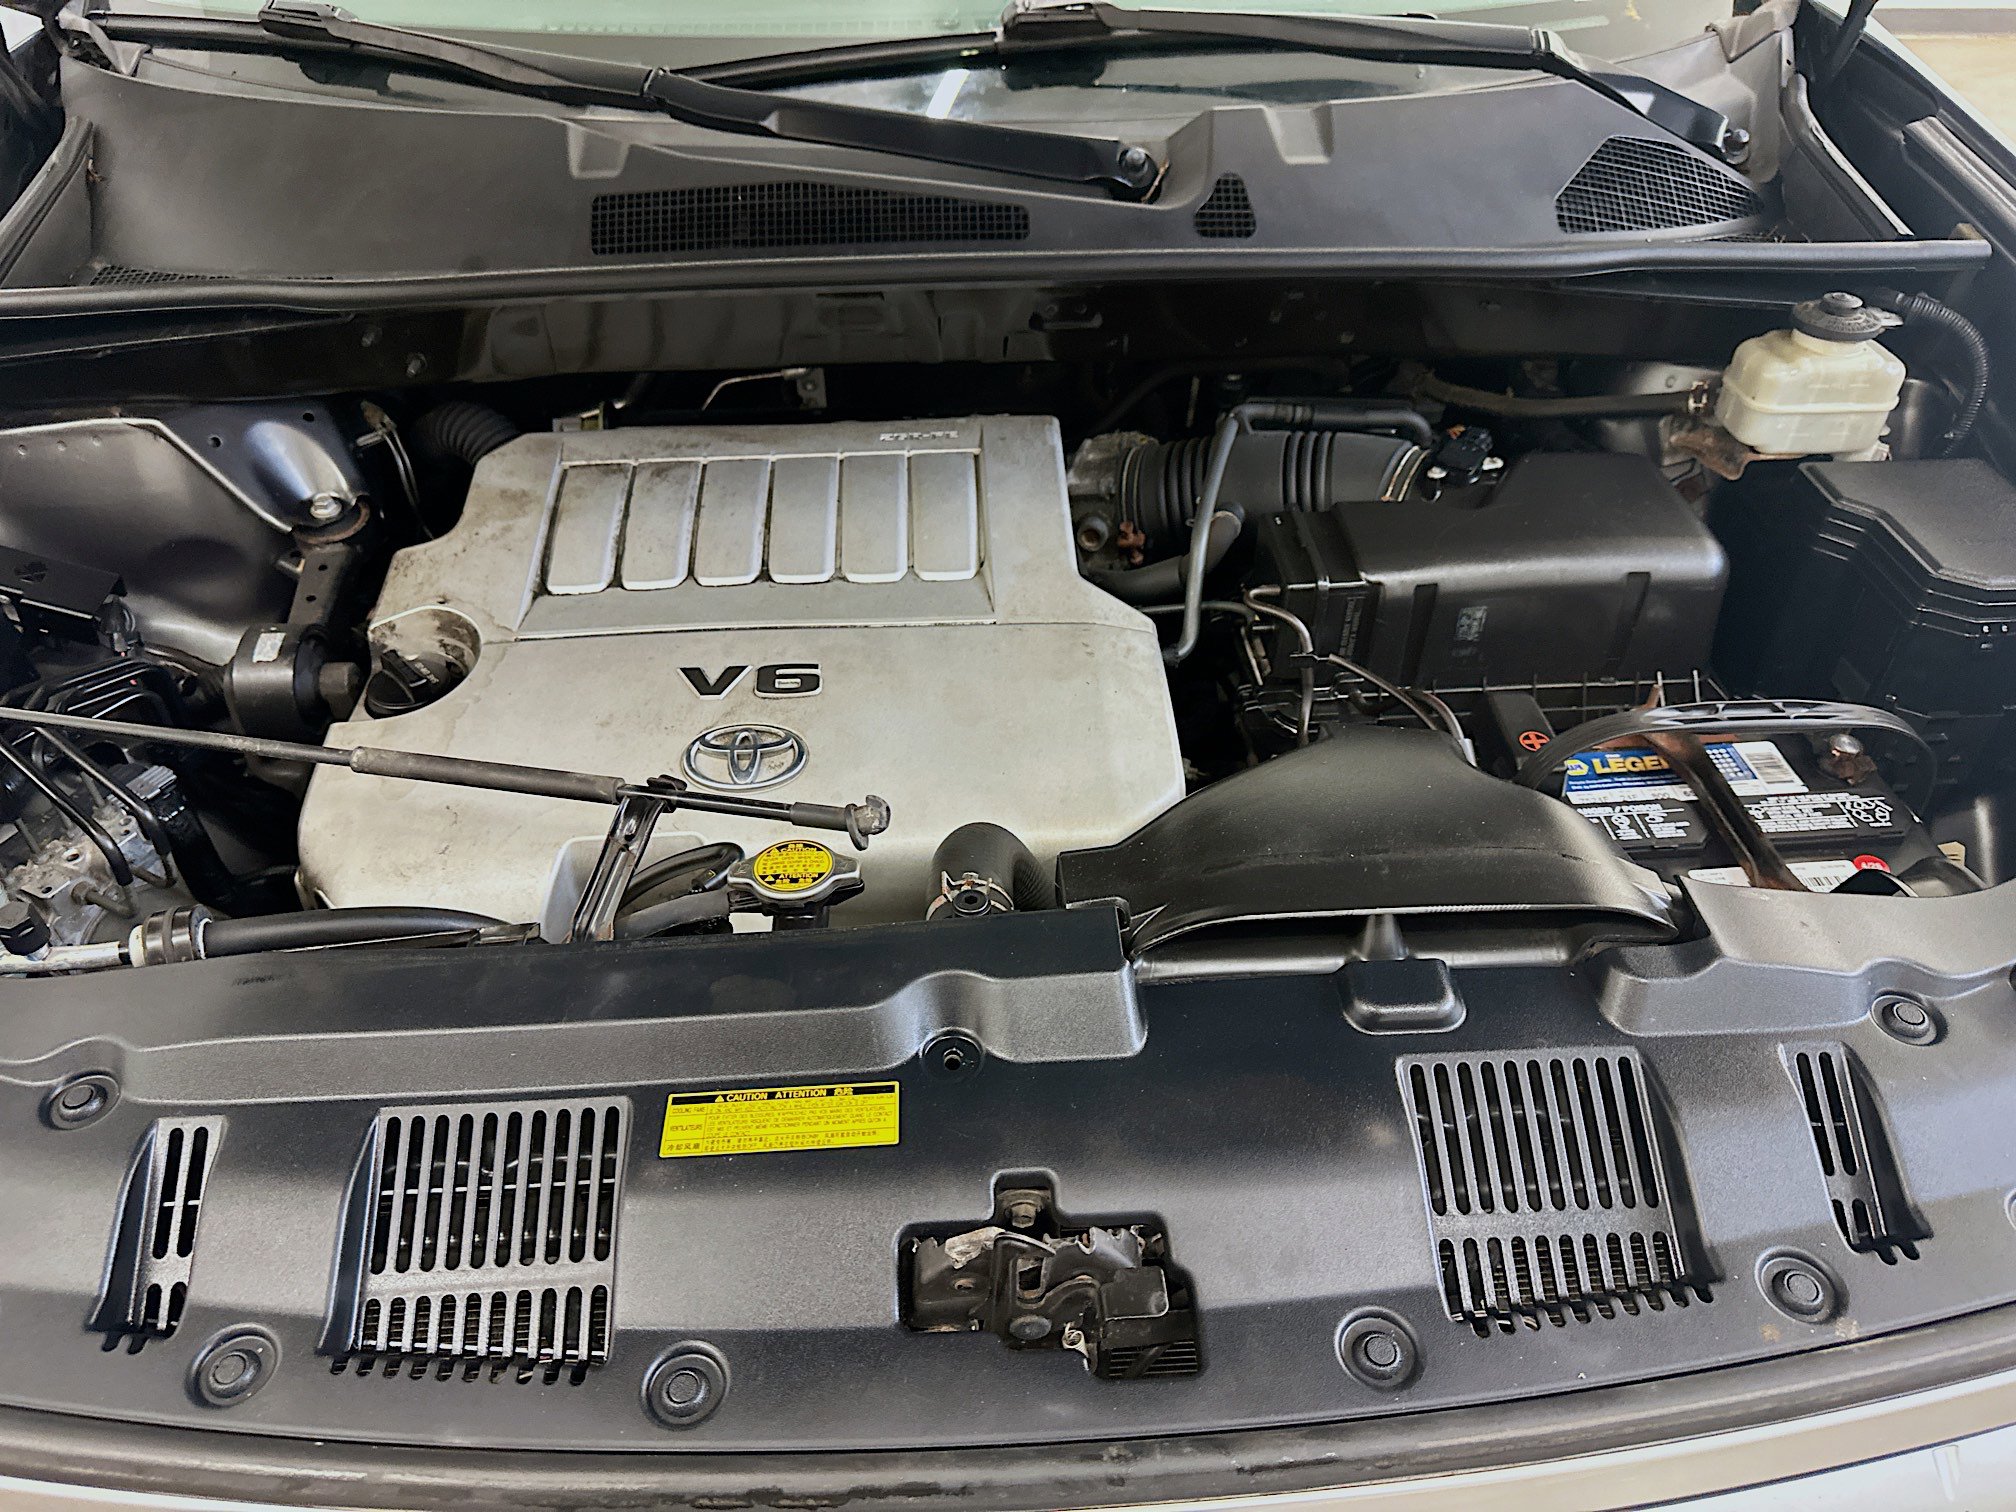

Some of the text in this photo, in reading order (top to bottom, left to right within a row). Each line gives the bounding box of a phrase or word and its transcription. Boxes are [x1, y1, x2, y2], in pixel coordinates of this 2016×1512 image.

[677, 663, 823, 700] V6
[726, 1092, 768, 1103] CAUTION
[775, 1088, 827, 1099] ATTENTION
